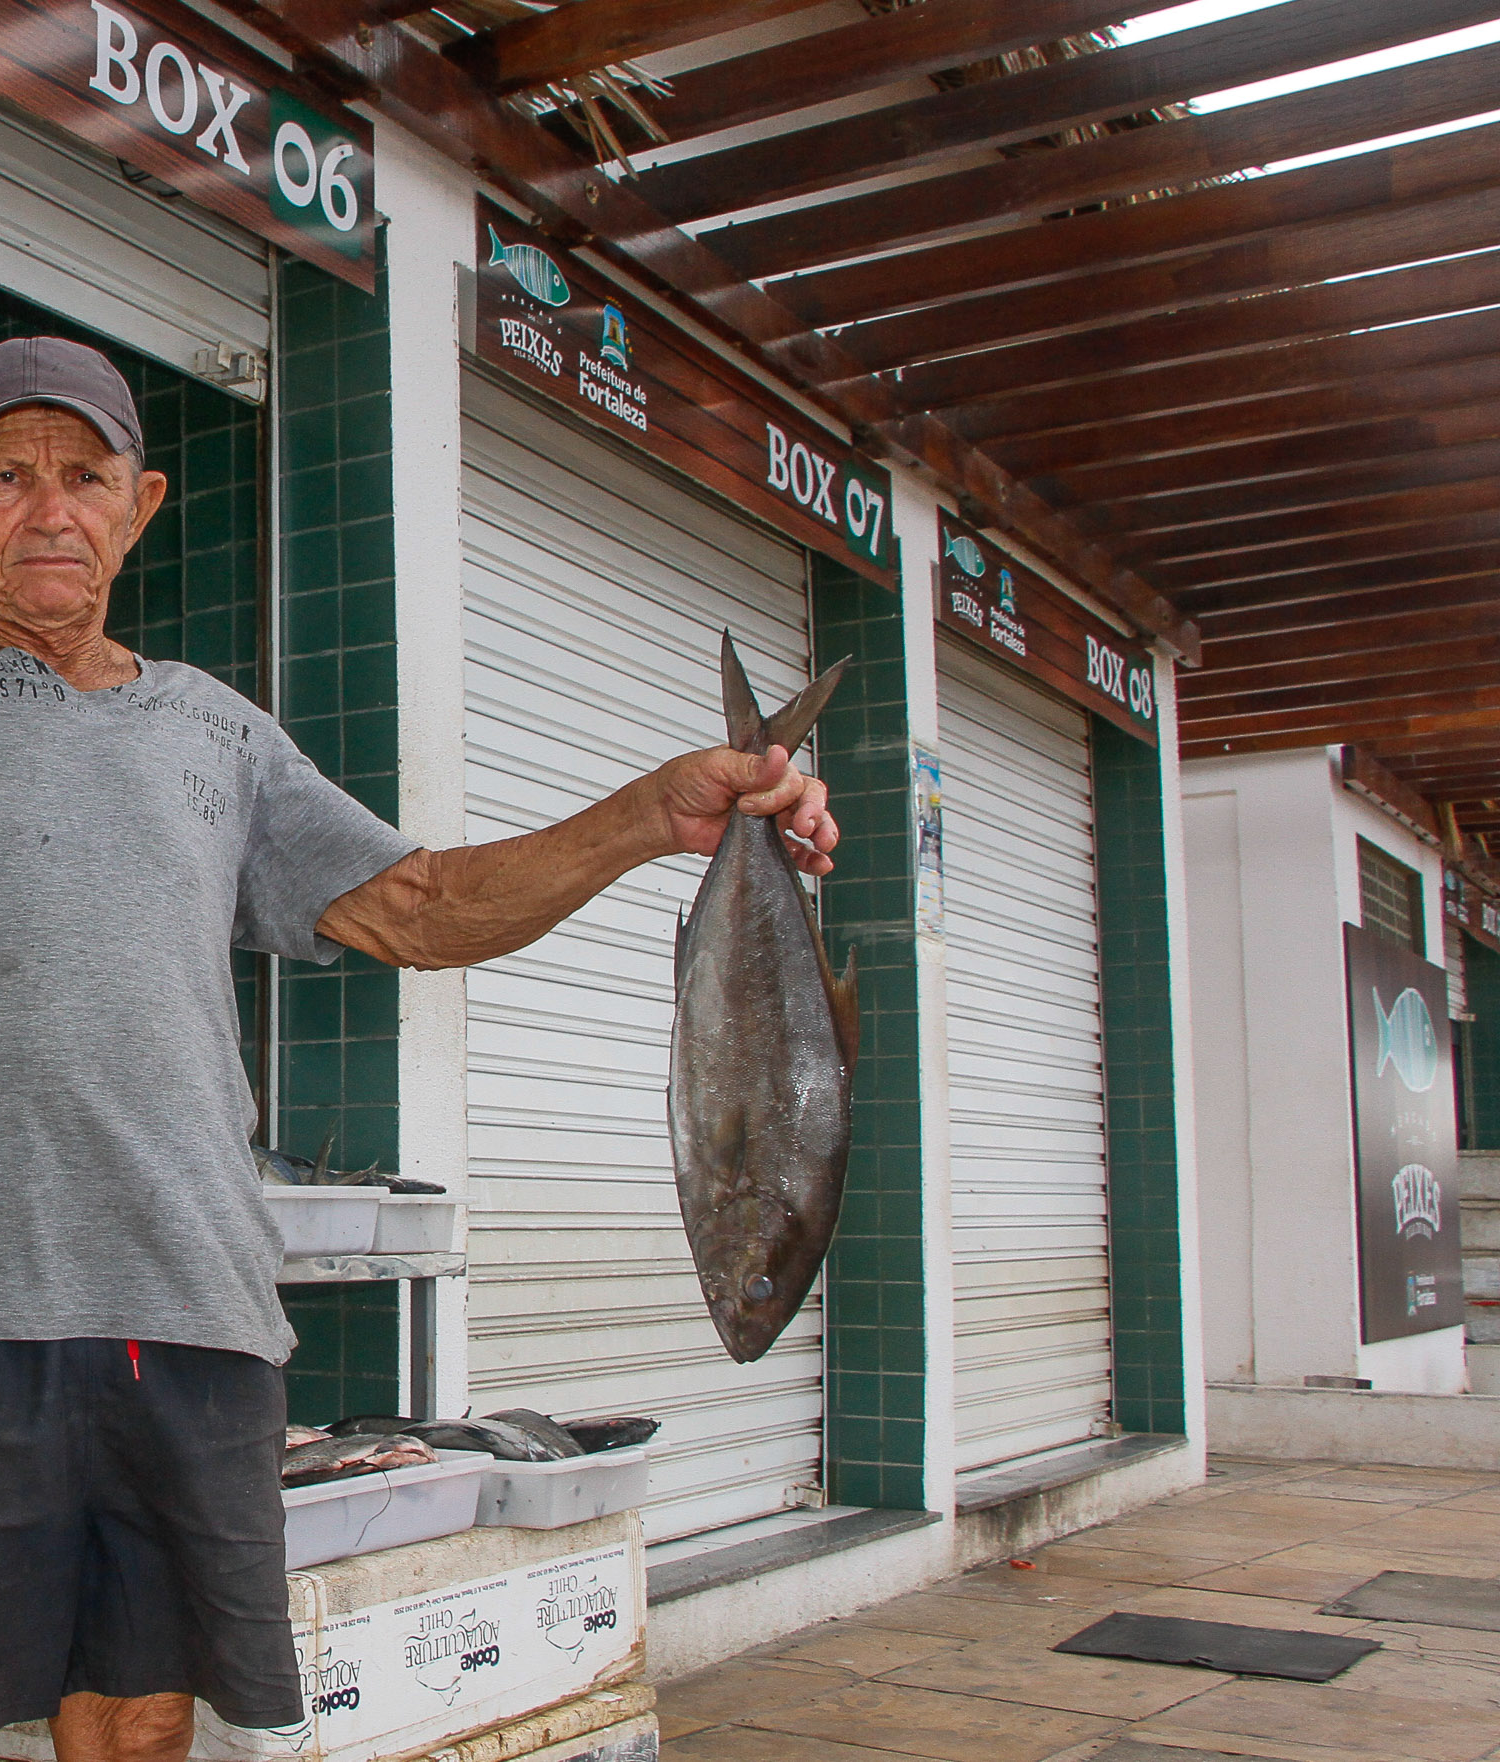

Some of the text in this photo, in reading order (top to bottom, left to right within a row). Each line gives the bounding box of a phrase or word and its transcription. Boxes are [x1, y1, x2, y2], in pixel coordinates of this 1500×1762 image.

[89, 0, 358, 232] BOX 06
[500, 318, 563, 376] PEIXES
[580, 351, 647, 405] Prefeitura de
[580, 371, 647, 431] Fortaleza
[766, 422, 884, 556] BOX 07
[1085, 634, 1152, 719] BOX 08
[536, 1586, 618, 1628] AQUACULTURE
[549, 1575, 578, 1596] CHILE
[404, 1620, 500, 1668] AQUACULTURE
[420, 1609, 453, 1632] CHILE
[583, 1609, 617, 1634] Cooke
[460, 1645, 499, 1672] Cooke
[312, 1687, 360, 1716] Cooke
